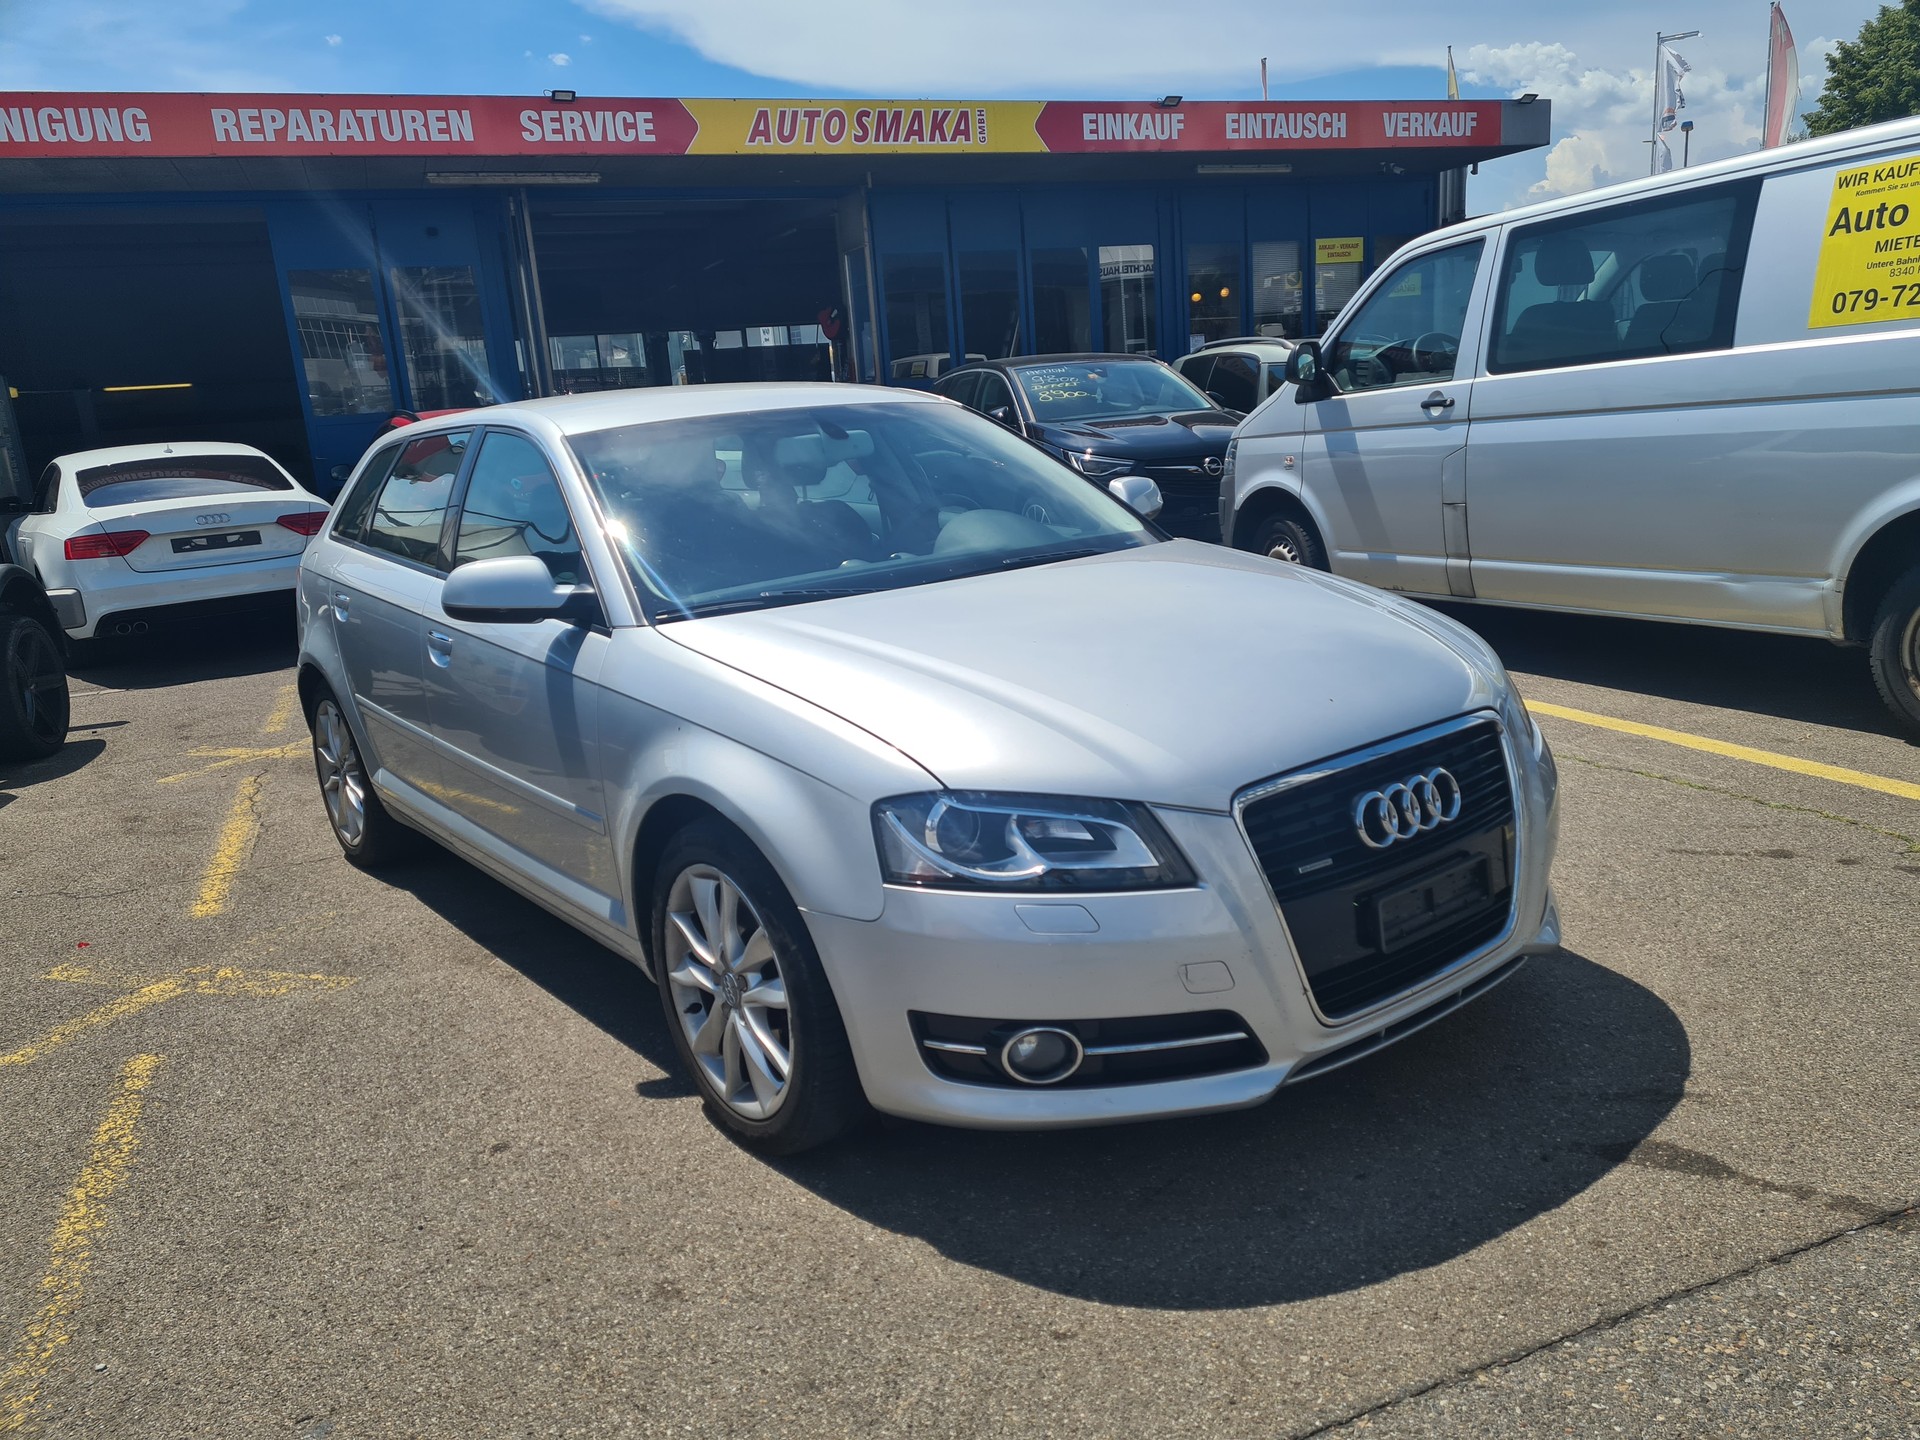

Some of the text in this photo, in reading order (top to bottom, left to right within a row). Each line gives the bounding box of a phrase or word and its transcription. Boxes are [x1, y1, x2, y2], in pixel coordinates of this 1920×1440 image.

[211, 108, 473, 142] REPARATUREN
[519, 109, 656, 142] SERVICE
[745, 108, 972, 145] AUTO SMAKA
[976, 108, 987, 144] GMBH
[1083, 112, 1477, 140] EINKAUF EINTAUSCH VERKAUF
[1837, 162, 1920, 189] WIR KAUF
[1855, 187, 1886, 197] Kommen
[1829, 202, 1909, 236] Auto
[1866, 260, 1895, 270] Untere
[1889, 266, 1915, 277] 8340
[1832, 283, 1920, 313] 079-72
